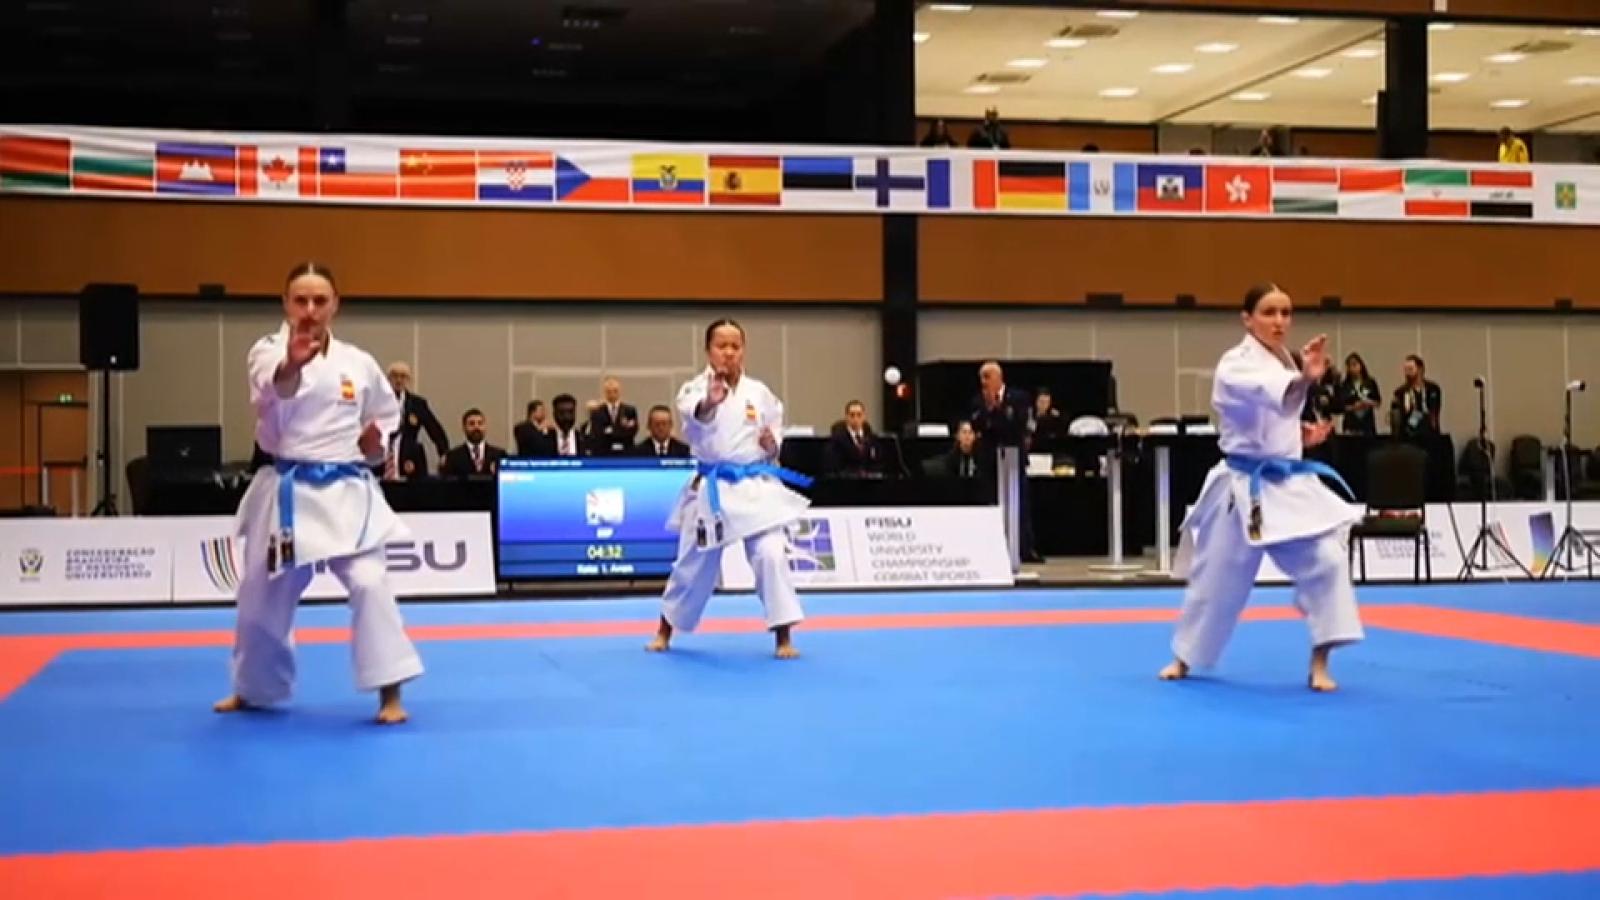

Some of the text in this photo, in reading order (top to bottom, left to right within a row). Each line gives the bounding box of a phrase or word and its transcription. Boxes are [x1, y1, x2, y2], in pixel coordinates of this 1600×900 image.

[865, 517, 912, 528] FISU
[867, 531, 916, 541] WORLD
[869, 544, 943, 555] UNIVERSITY
[871, 557, 970, 569] CHAMPIONSHIP
[873, 570, 980, 581] COMBAT SPORTS
